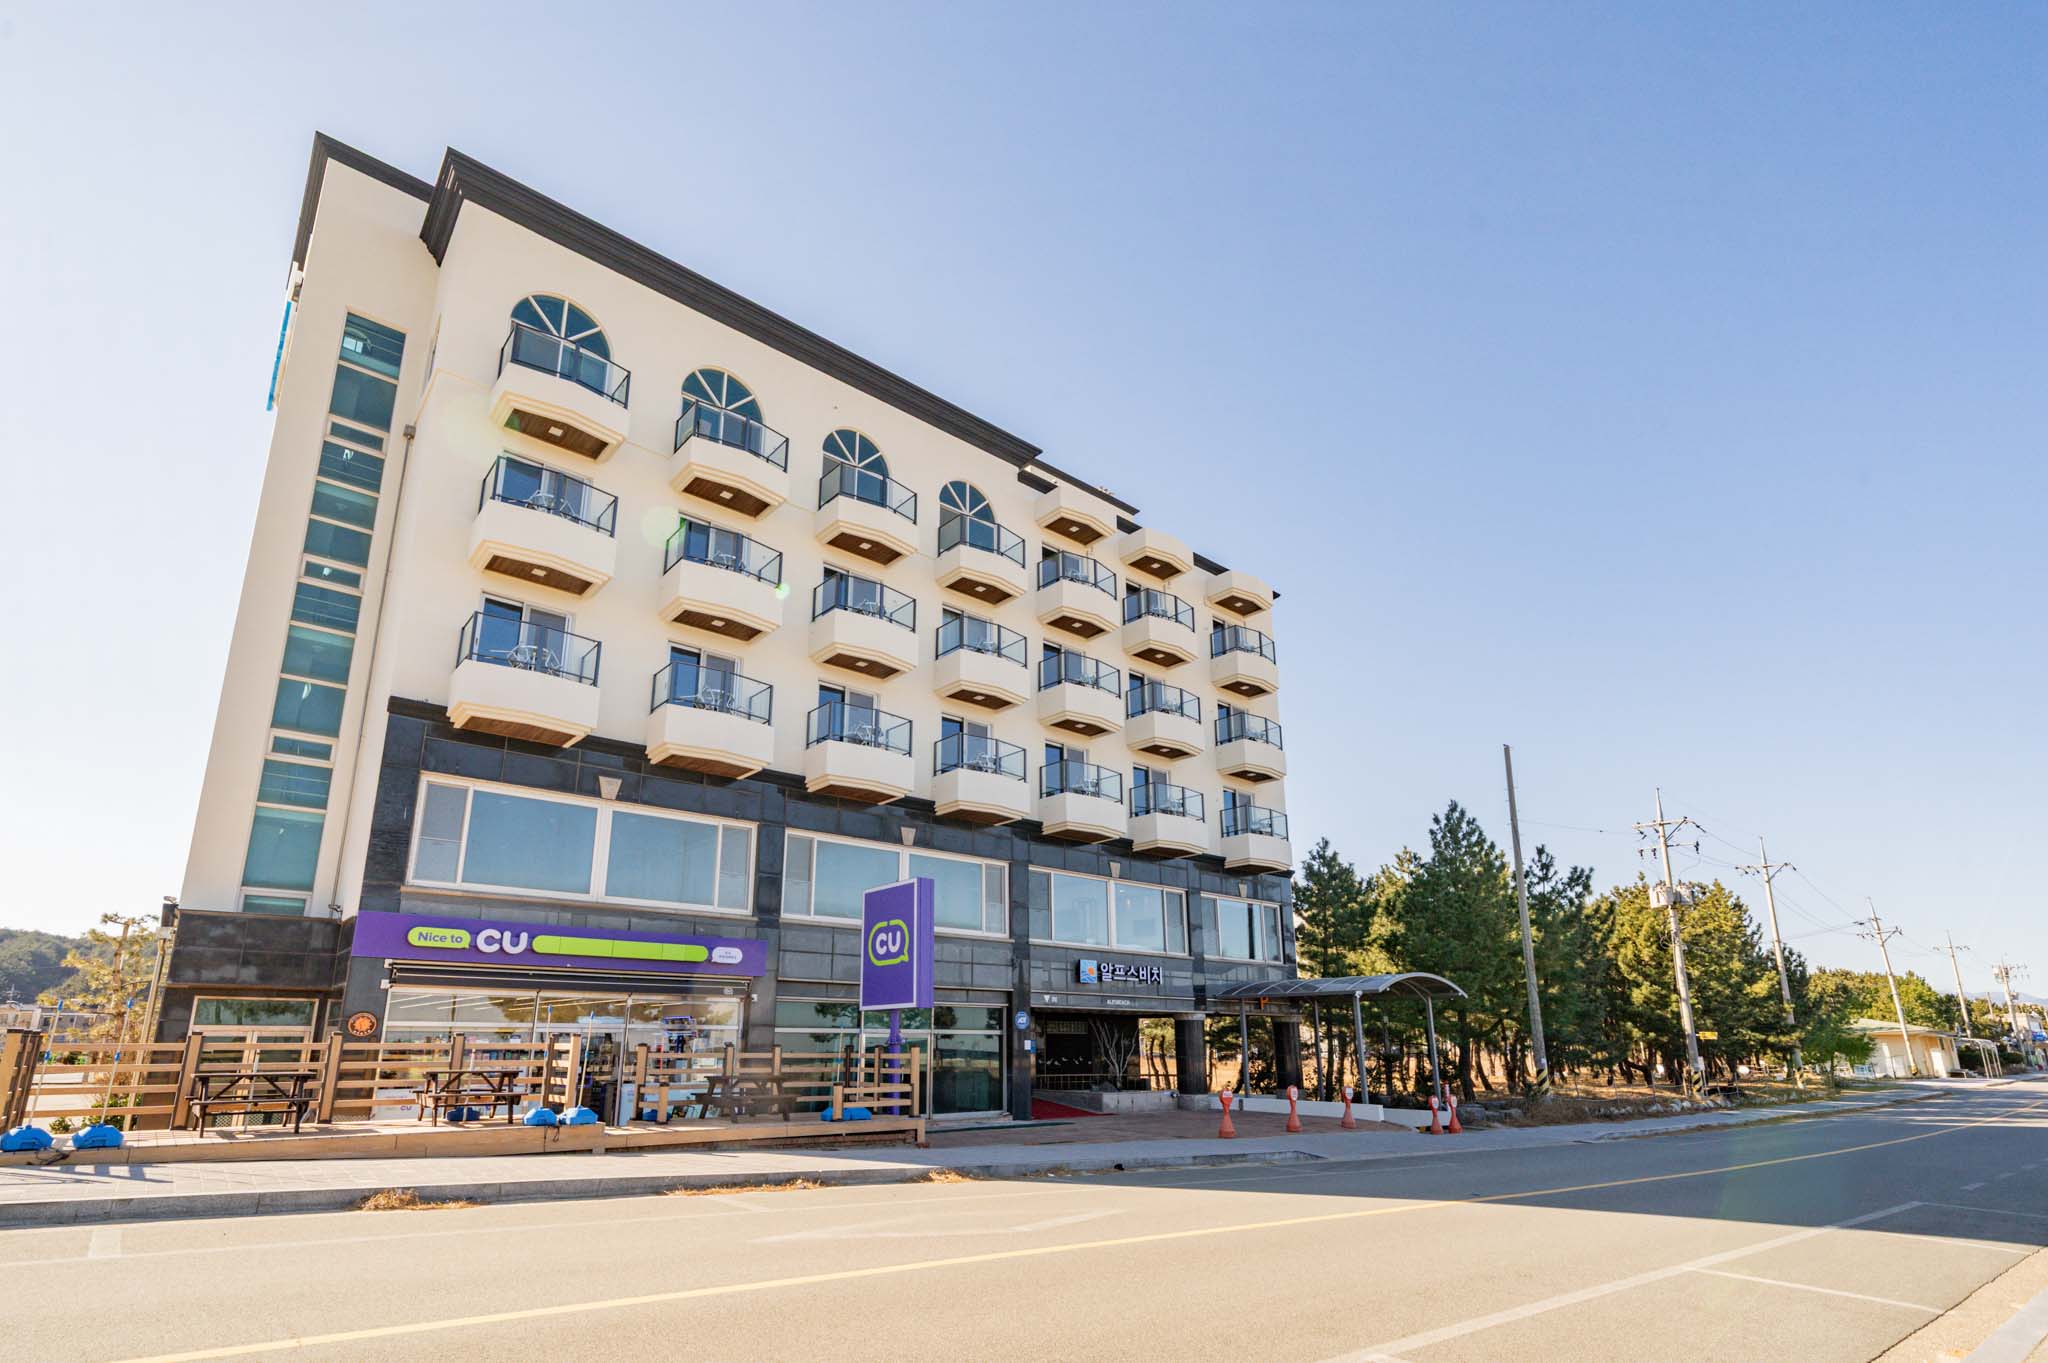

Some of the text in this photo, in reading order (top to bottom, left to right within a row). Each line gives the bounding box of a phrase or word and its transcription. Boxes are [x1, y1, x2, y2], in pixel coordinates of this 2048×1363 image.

[418, 929, 528, 954] Nice to CU
[876, 930, 901, 955] CU
[1100, 963, 1163, 985] 알프스비치
